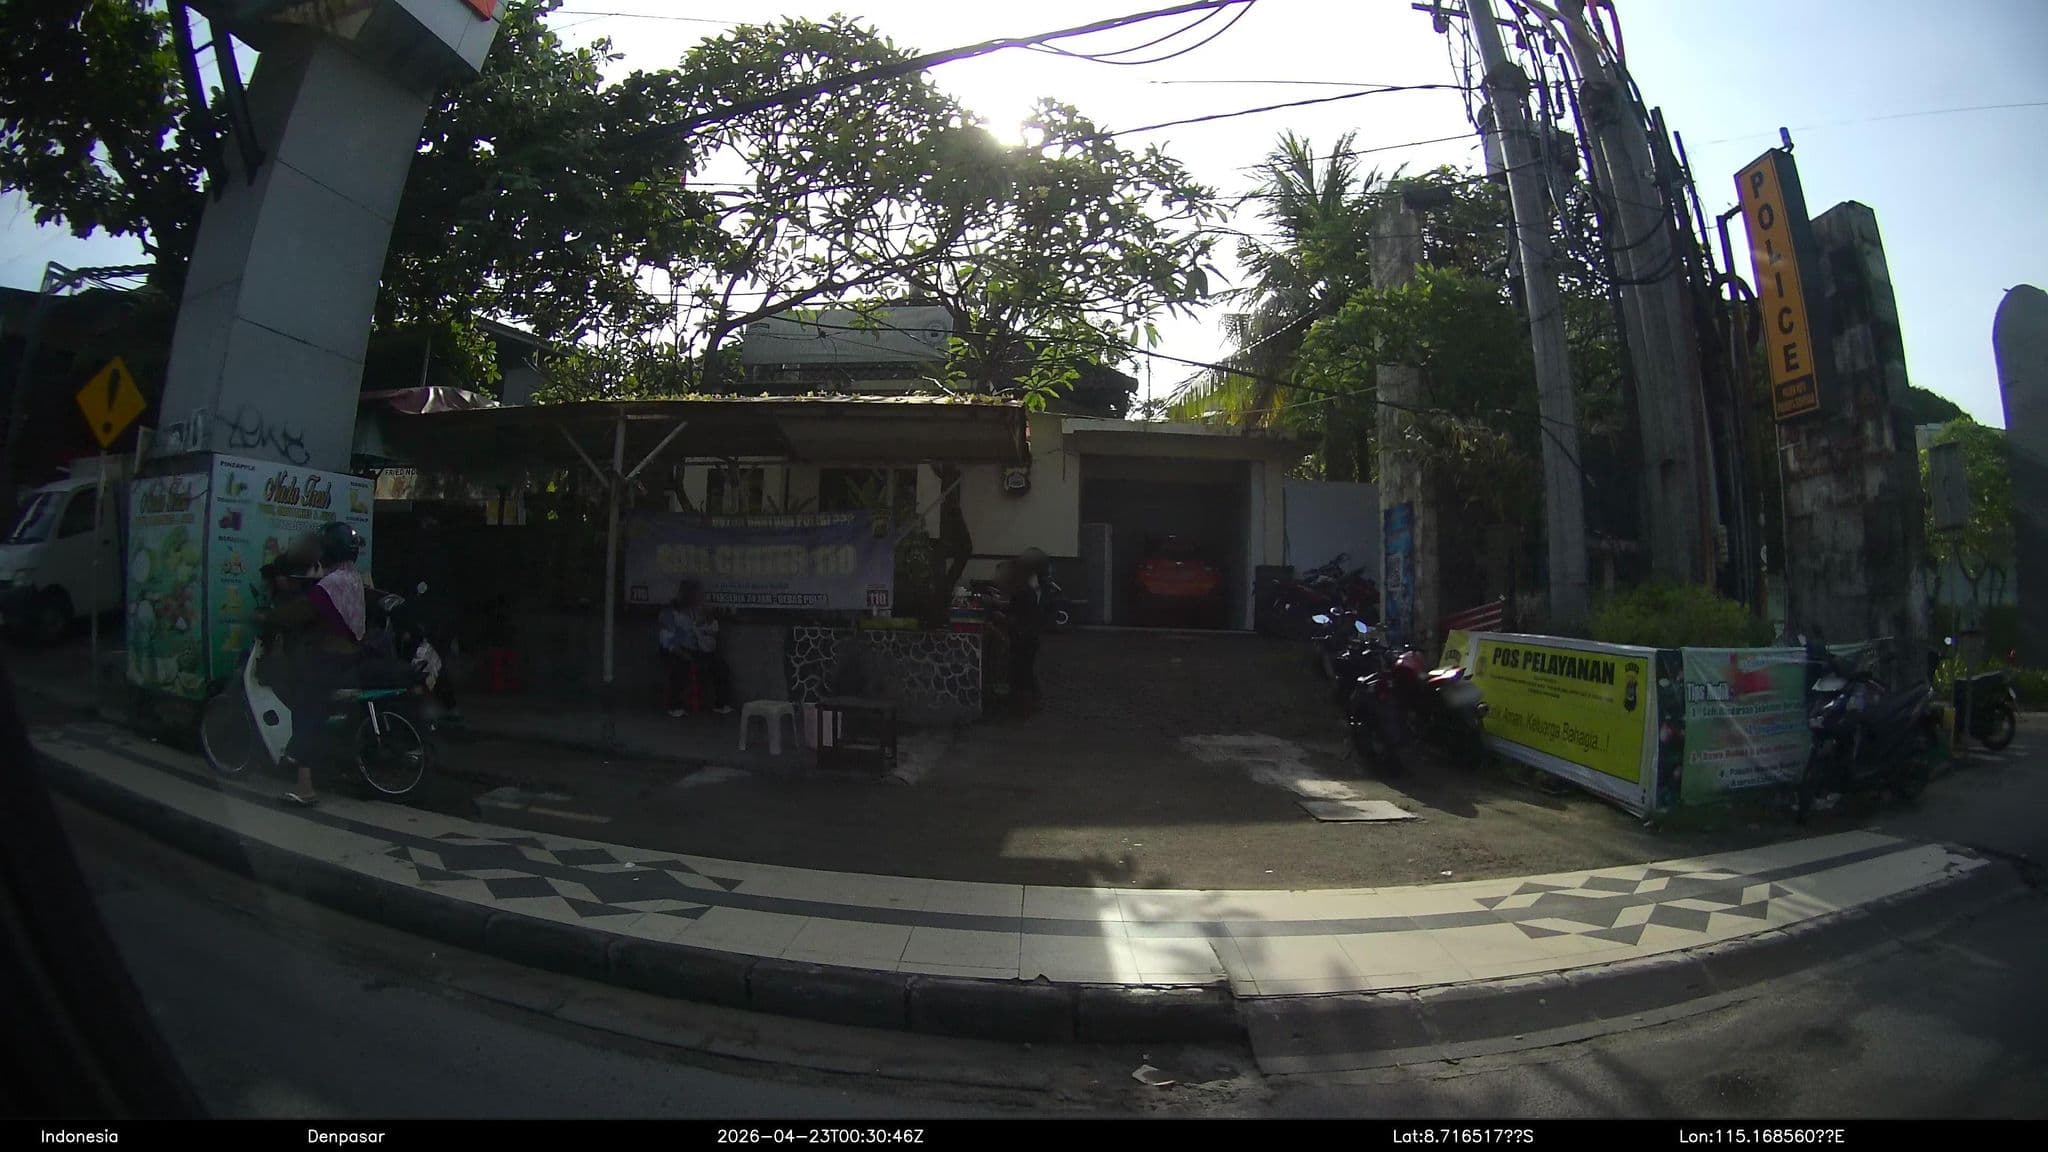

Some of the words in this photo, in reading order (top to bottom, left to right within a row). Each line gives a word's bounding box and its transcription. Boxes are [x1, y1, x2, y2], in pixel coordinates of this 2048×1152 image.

[1750, 171, 1800, 373] POLICE
[1492, 647, 1520, 669] POS
[1522, 651, 1616, 685] PELAYANAN
[1526, 713, 1561, 742] Keluarga
